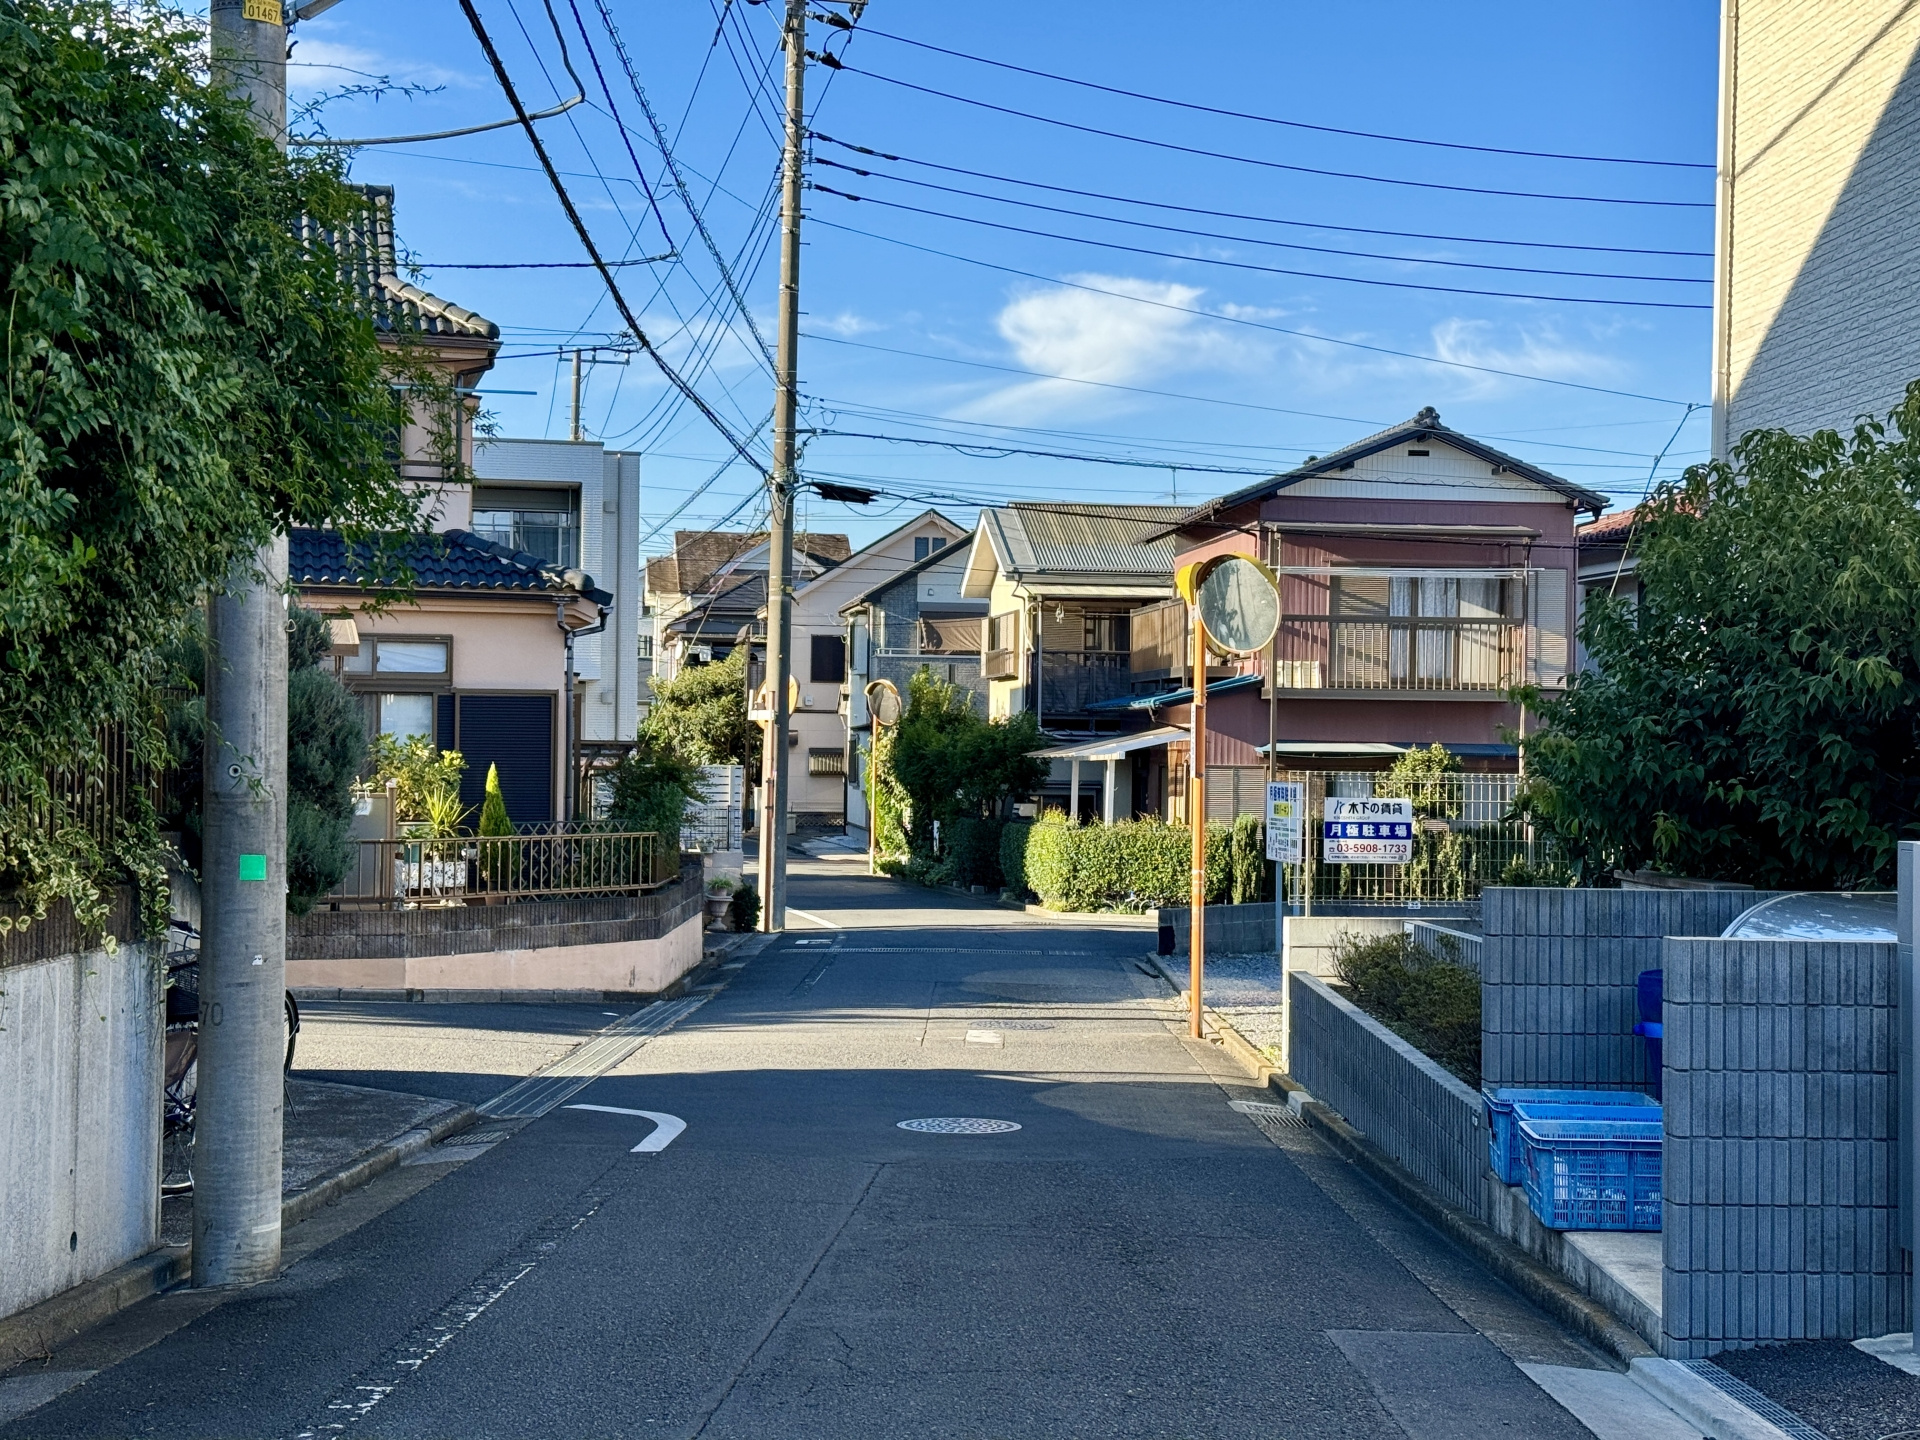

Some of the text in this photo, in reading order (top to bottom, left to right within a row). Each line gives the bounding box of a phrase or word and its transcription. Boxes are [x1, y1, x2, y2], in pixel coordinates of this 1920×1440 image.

[248, 4, 278, 22] 01467
[1348, 801, 1403, 815] 木下の賃貸
[1330, 823, 1407, 837] 月極駐車場
[1336, 843, 1407, 853] 03-5908-1733
